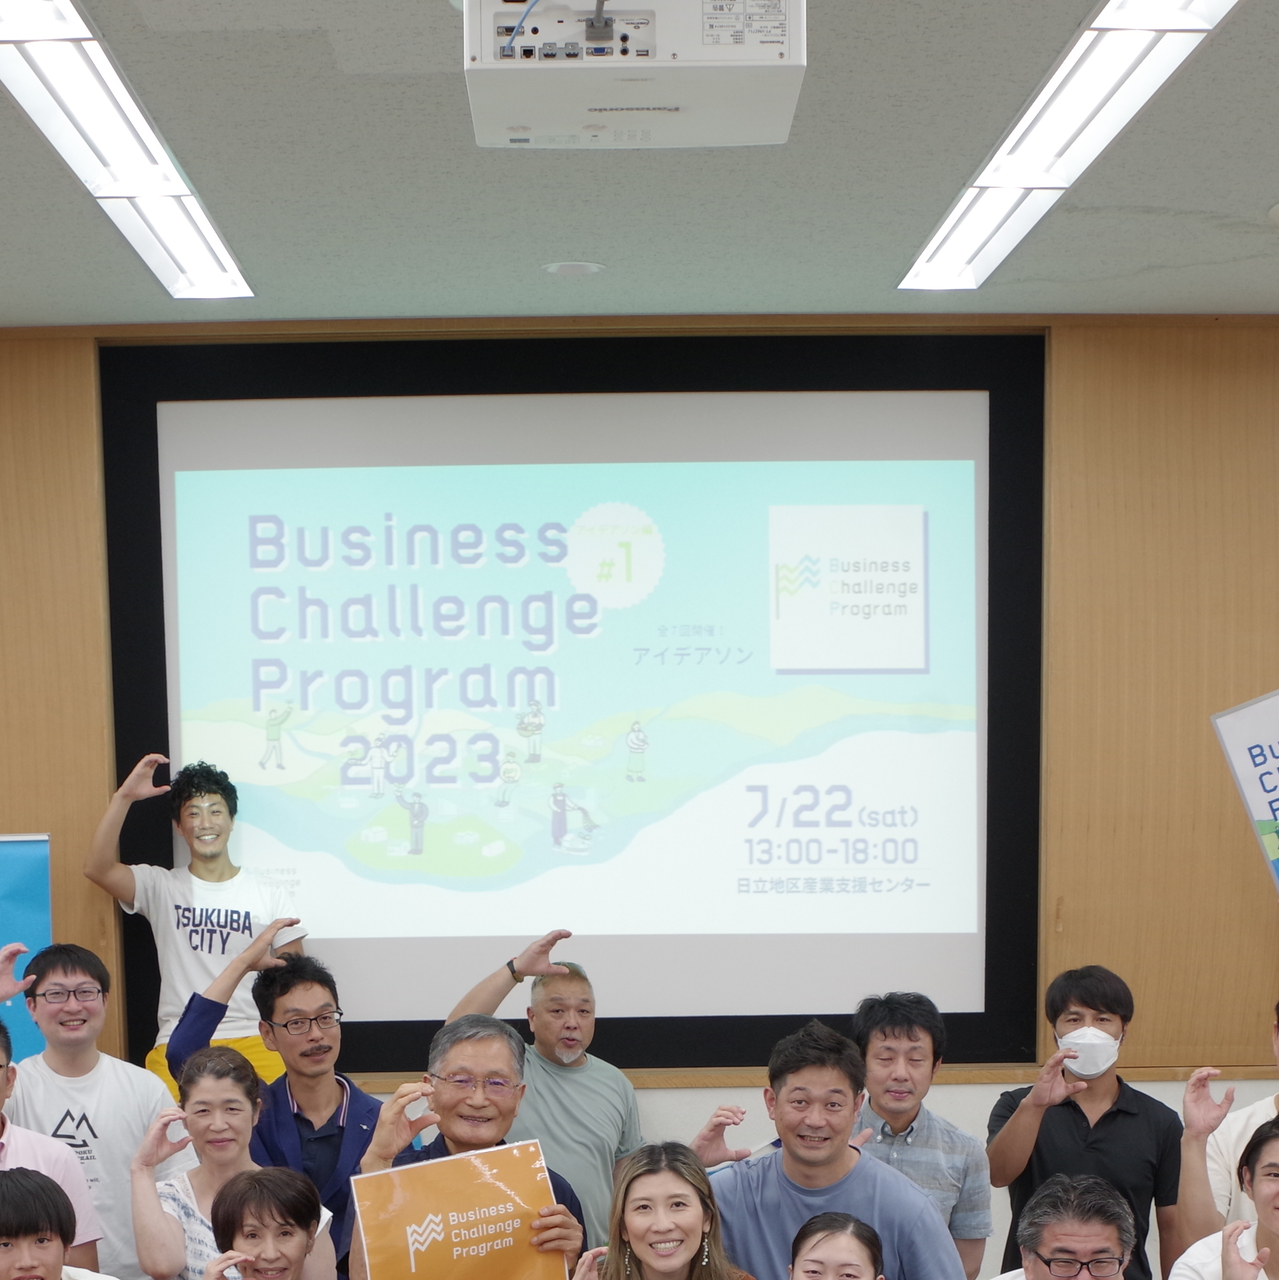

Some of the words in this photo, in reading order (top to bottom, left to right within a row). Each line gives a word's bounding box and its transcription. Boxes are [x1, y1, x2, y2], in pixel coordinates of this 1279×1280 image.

[248, 512, 570, 570] Business
[596, 541, 633, 583] #1
[829, 558, 912, 573] Business
[250, 583, 600, 653] Challenge
[829, 602, 908, 620] Program
[633, 647, 754, 666] アイデアソン
[251, 657, 556, 727] Program
[339, 732, 501, 787] 2023
[743, 838, 919, 865] 13:00-18:00
[736, 877, 932, 894] 日立地区産業支援センター
[174, 904, 253, 938] TSUKUBA
[189, 928, 231, 955] CITY
[448, 1202, 514, 1225] Business
[451, 1217, 521, 1242] Challenge
[453, 1236, 514, 1259] Program
